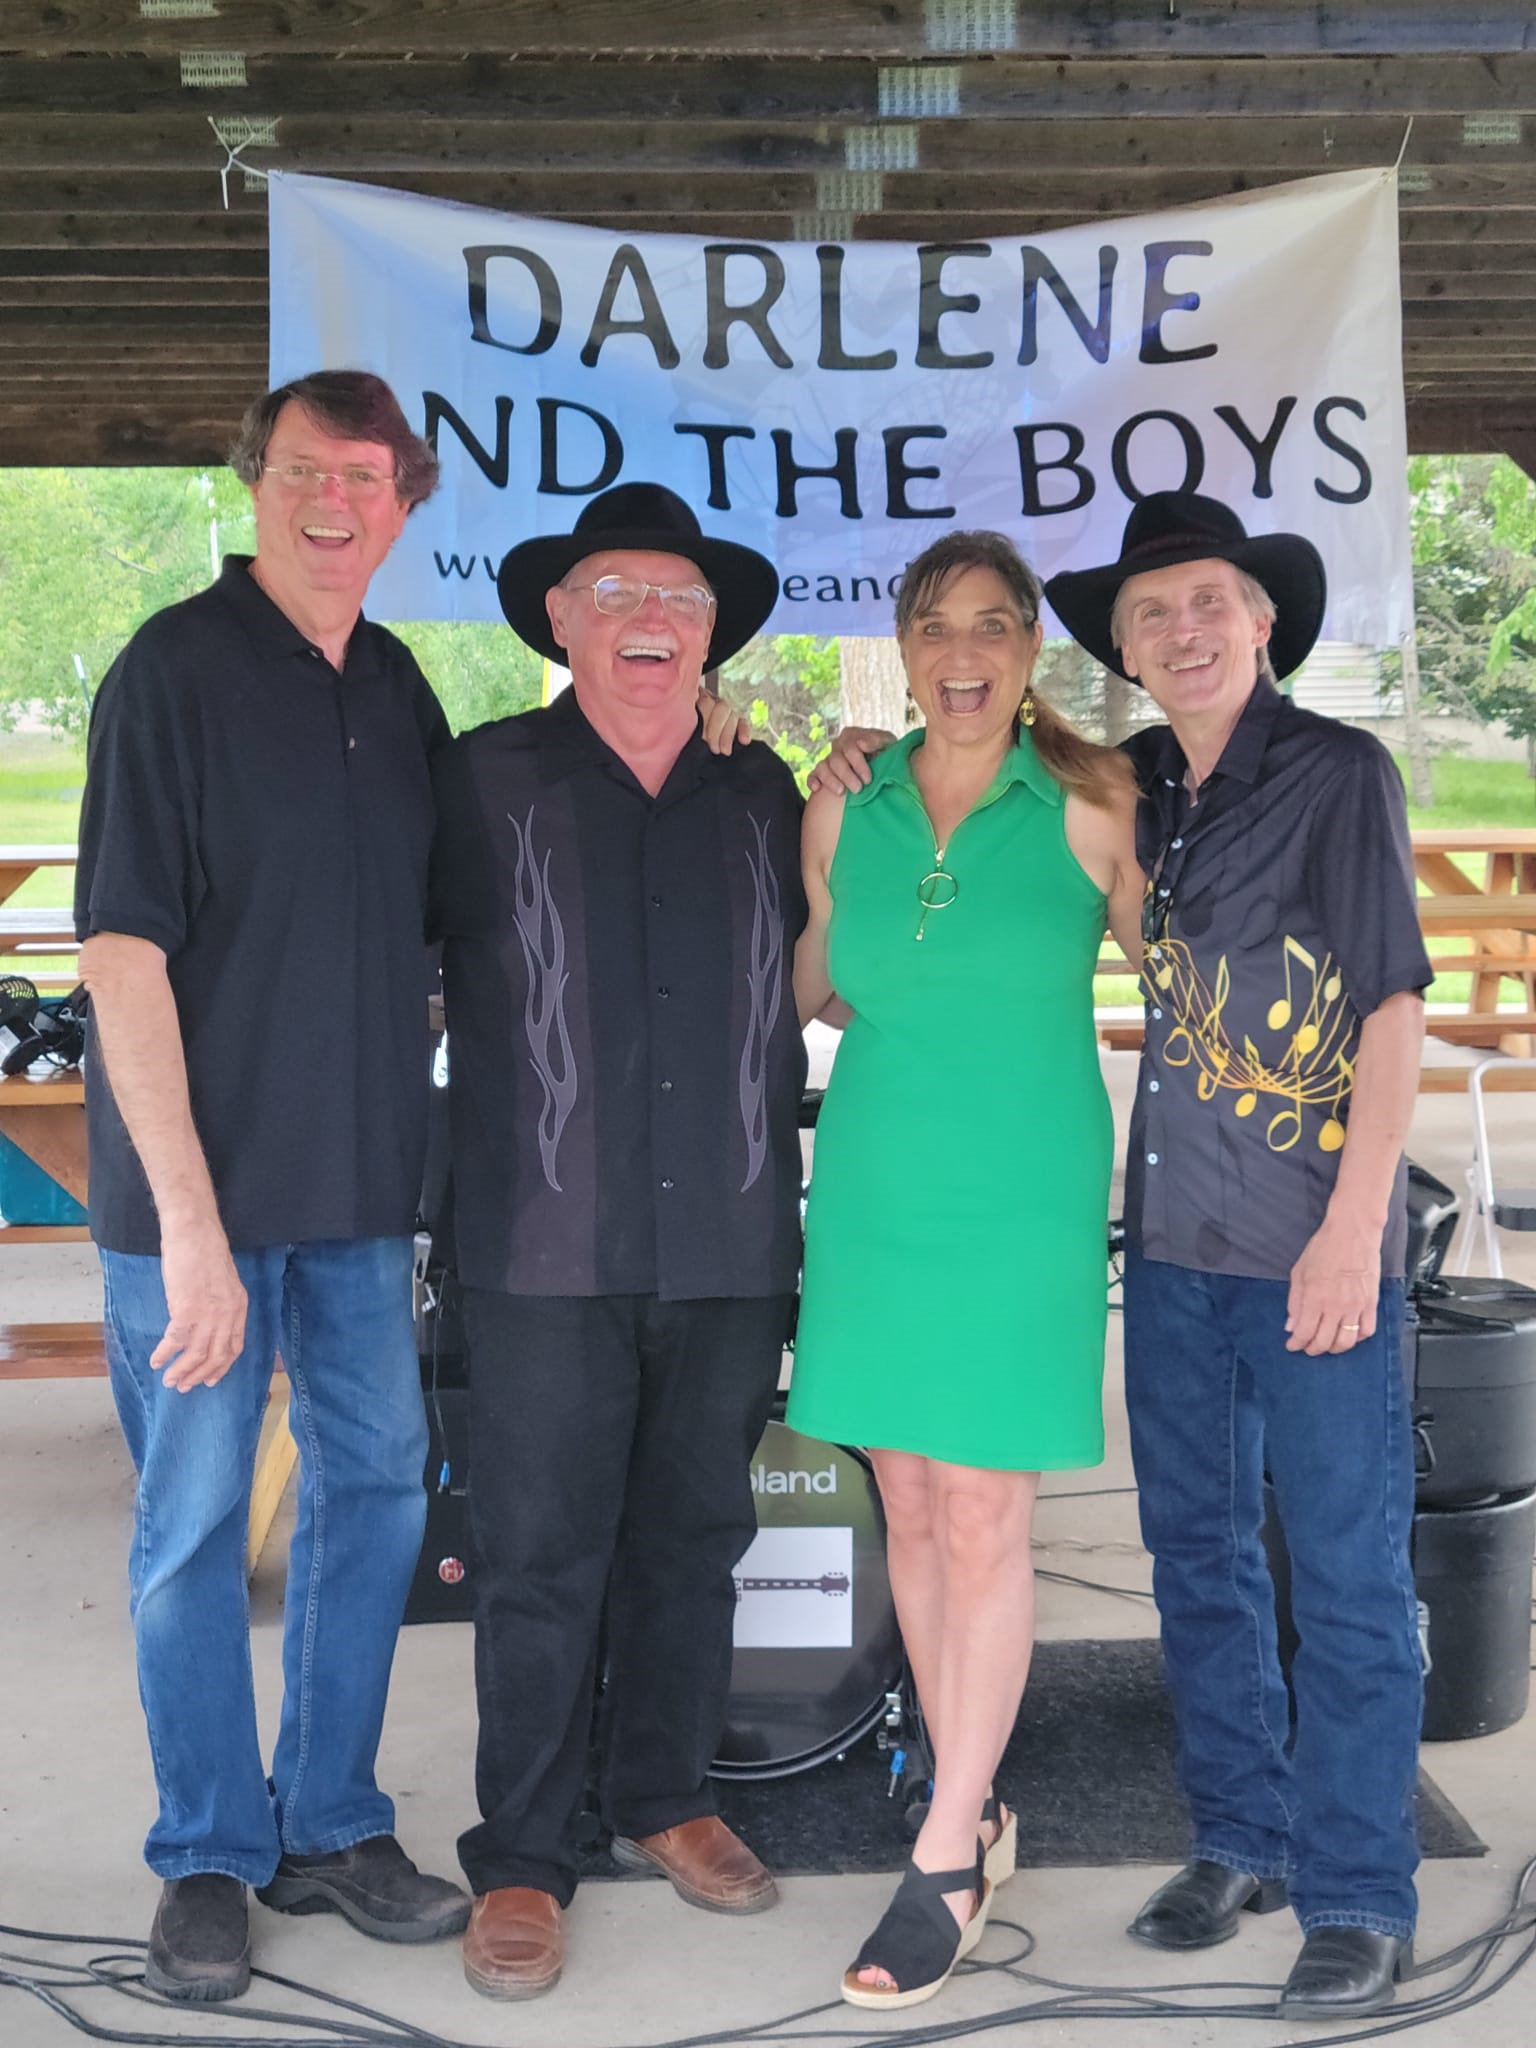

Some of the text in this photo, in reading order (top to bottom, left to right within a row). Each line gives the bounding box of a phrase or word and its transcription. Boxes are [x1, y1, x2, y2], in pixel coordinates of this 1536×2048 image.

[462, 241, 1218, 370] DARLENE
[421, 391, 1372, 519] ND THE BOYS
